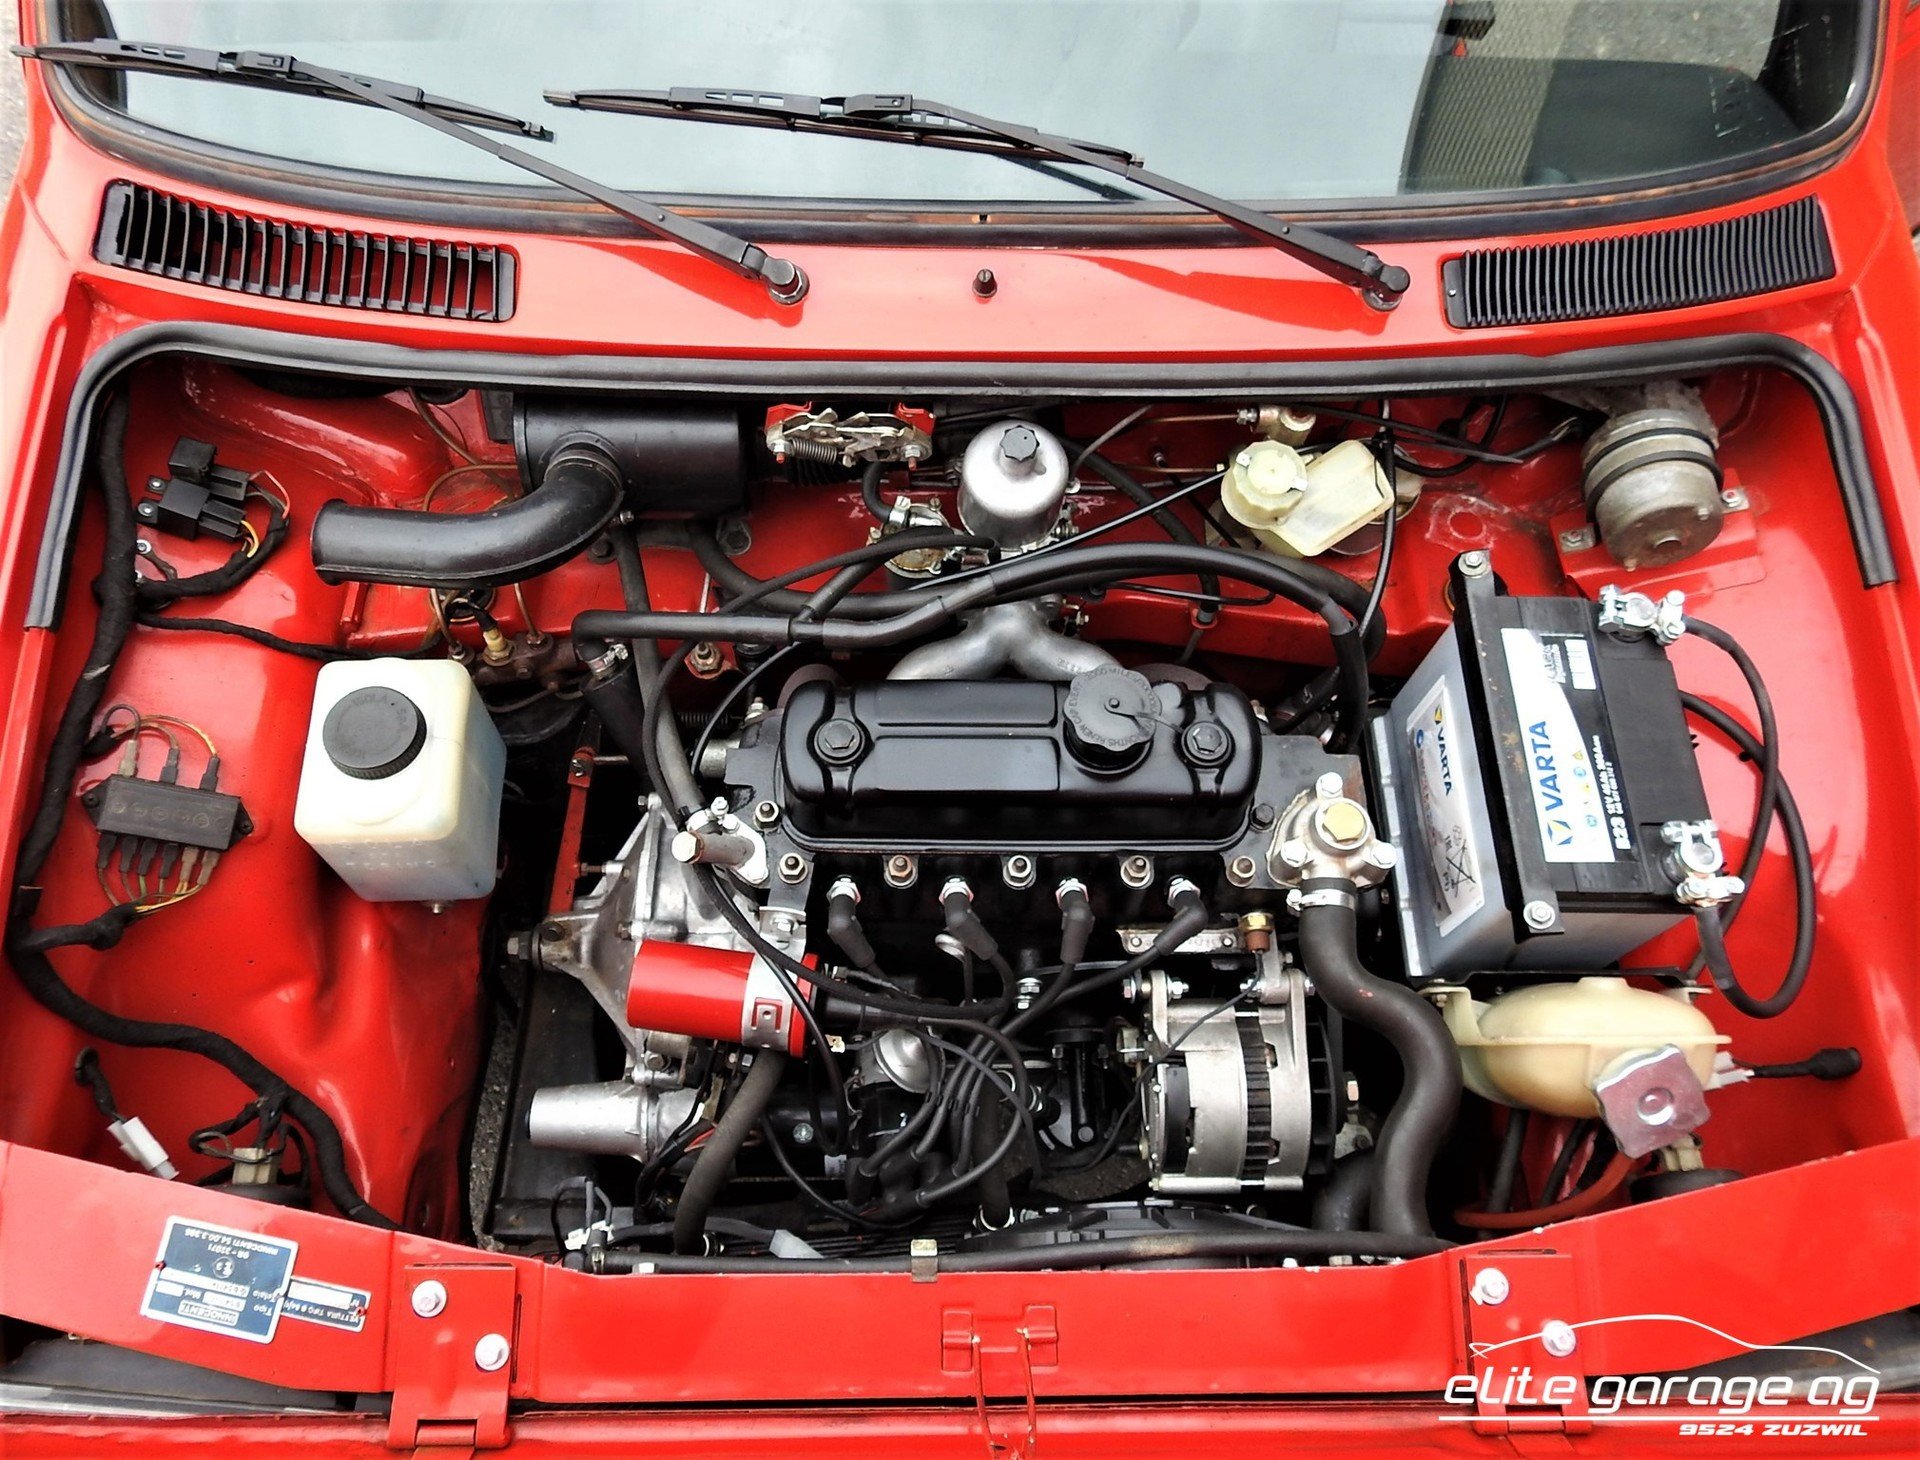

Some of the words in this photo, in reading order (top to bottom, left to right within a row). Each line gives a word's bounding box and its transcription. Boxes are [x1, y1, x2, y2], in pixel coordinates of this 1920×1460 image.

[1437, 727, 1453, 796] VARTA
[1527, 721, 1563, 811] VARTA
[179, 1302, 236, 1324] INNOCENTI
[254, 1304, 273, 1316] Tipo
